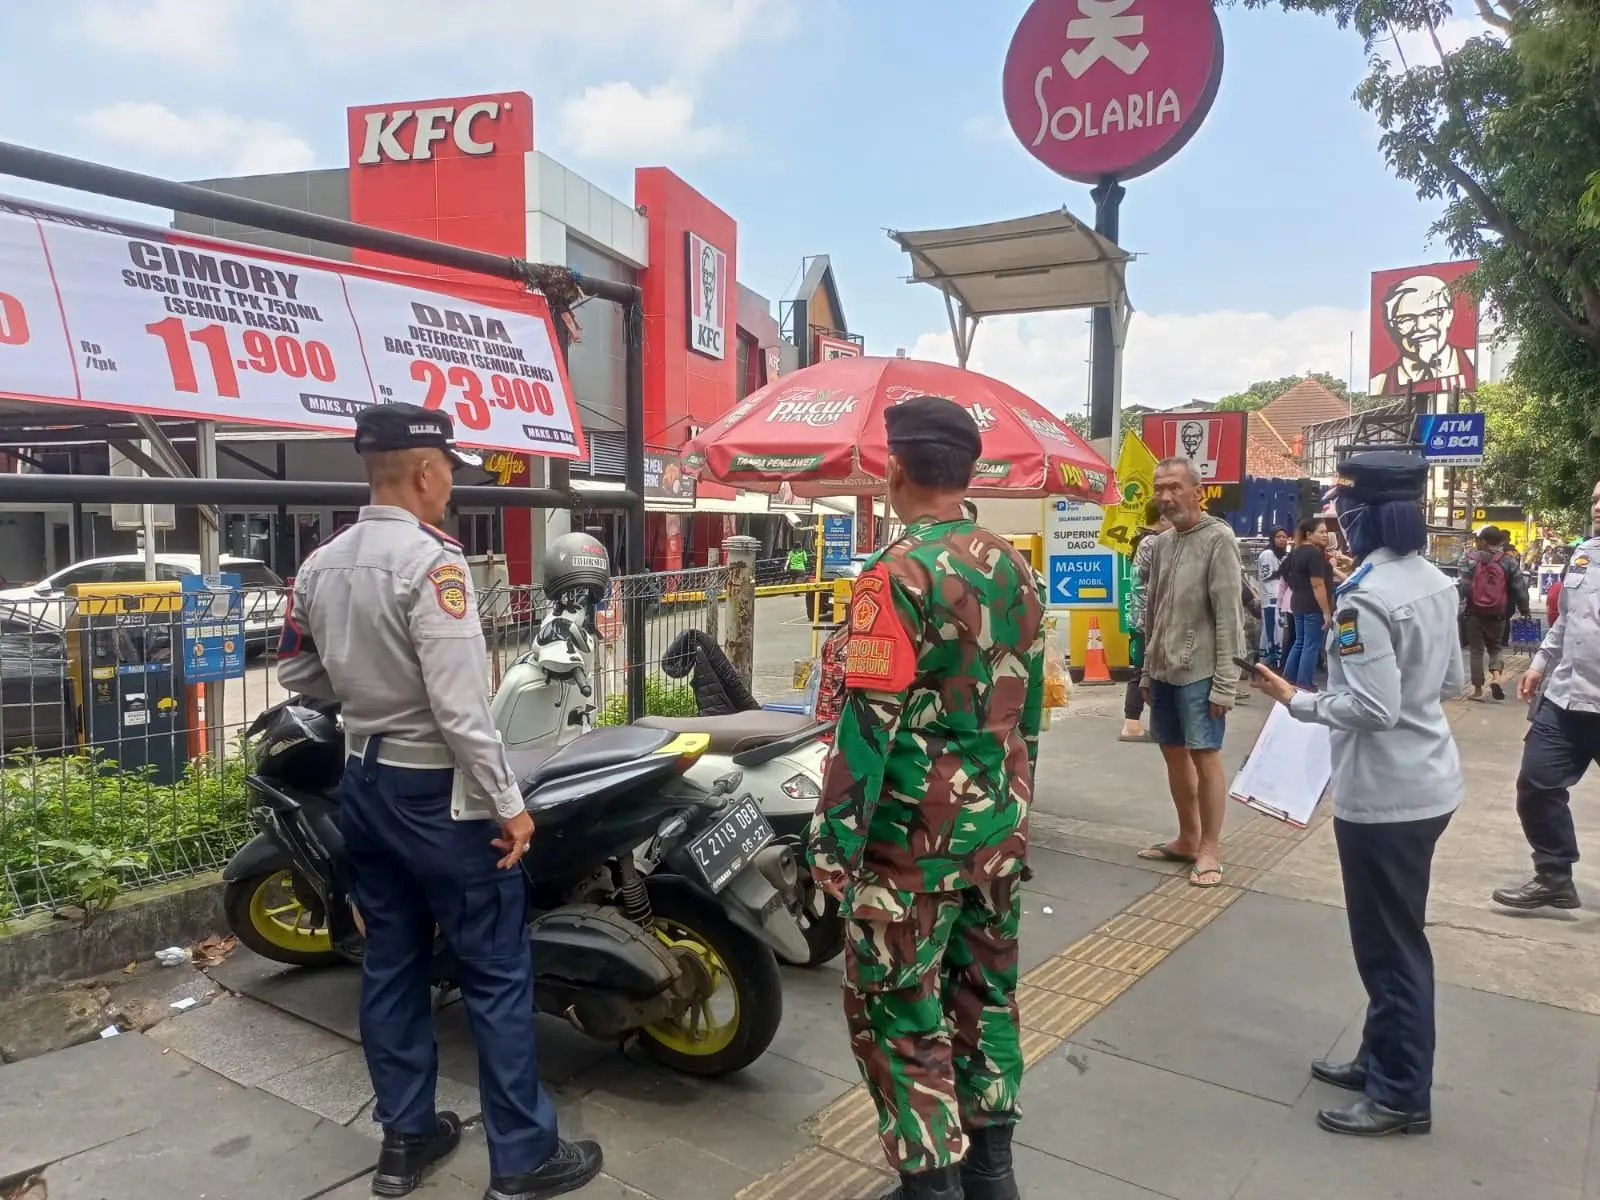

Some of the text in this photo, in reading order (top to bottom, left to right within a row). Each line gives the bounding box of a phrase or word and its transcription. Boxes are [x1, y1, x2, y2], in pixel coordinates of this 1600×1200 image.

[1031, 66, 1181, 146] SOLARIA
[358, 101, 499, 164] KFC
[128, 240, 299, 300] CIMORY
[121, 269, 323, 322] SUSU UHT TPK 750ML
[165, 296, 301, 334] (SEMUA RASA)
[411, 302, 512, 343] DAIA
[80, 340, 102, 356] Rp
[408, 325, 525, 361] DETERGENT BUBUK
[697, 323, 721, 352] KFC
[85, 356, 118, 373] /tpk
[145, 316, 336, 399] 11.900
[384, 336, 554, 382] BAG 1500GR (SEMUA JENIS)
[308, 397, 344, 413] MAKS.
[346, 402, 353, 414] 4
[410, 360, 555, 431] 23.900
[779, 413, 842, 426] HARUM
[1437, 420, 1472, 432] ATM
[1447, 436, 1479, 447] BCA
[1067, 541, 1095, 549] DAGO
[1055, 562, 1101, 572] MASUK
[695, 847, 710, 866] Z
[708, 822, 737, 856] 2119
[735, 803, 758, 830] DBB
